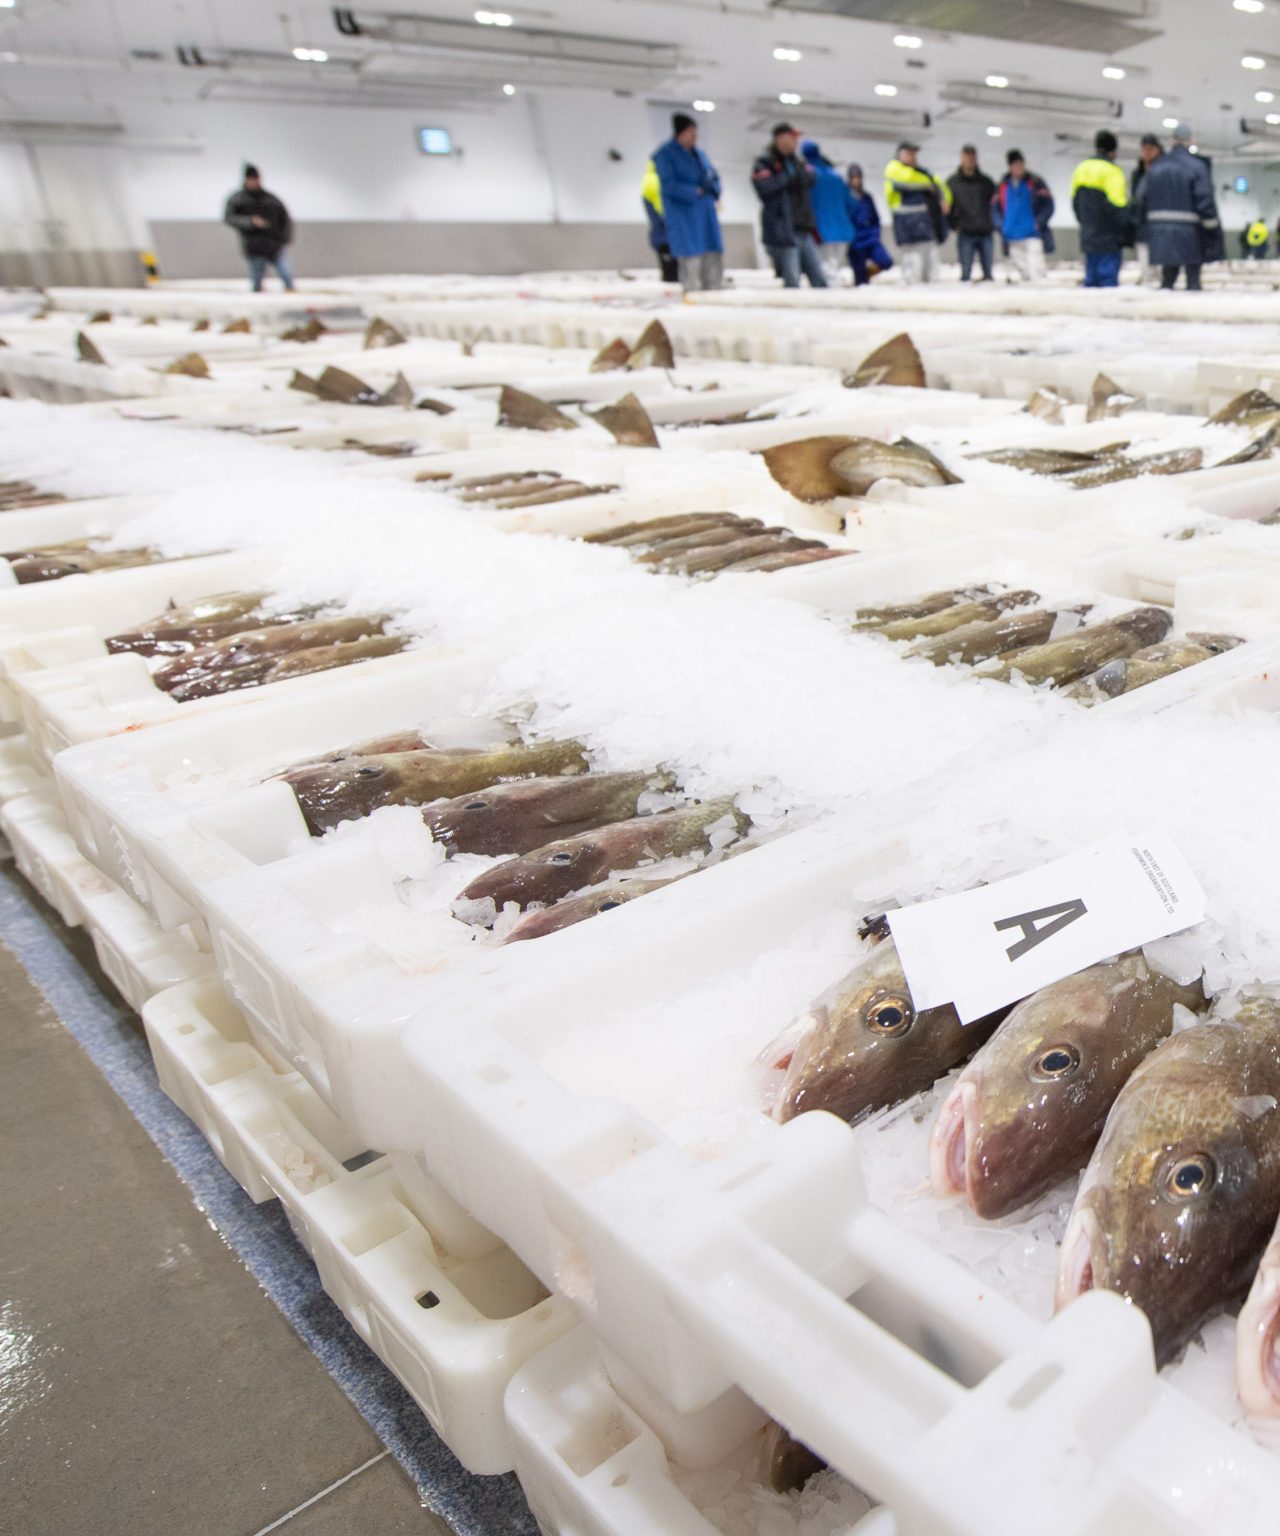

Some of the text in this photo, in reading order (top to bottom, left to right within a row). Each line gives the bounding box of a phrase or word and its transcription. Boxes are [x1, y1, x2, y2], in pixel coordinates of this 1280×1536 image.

[1142, 849, 1154, 861] NORTH
[1150, 861, 1161, 872] EAST
[1160, 877, 1179, 904] SCOTLAND
[1145, 869, 1169, 903] ORGANISATION
[993, 897, 1088, 962] A
